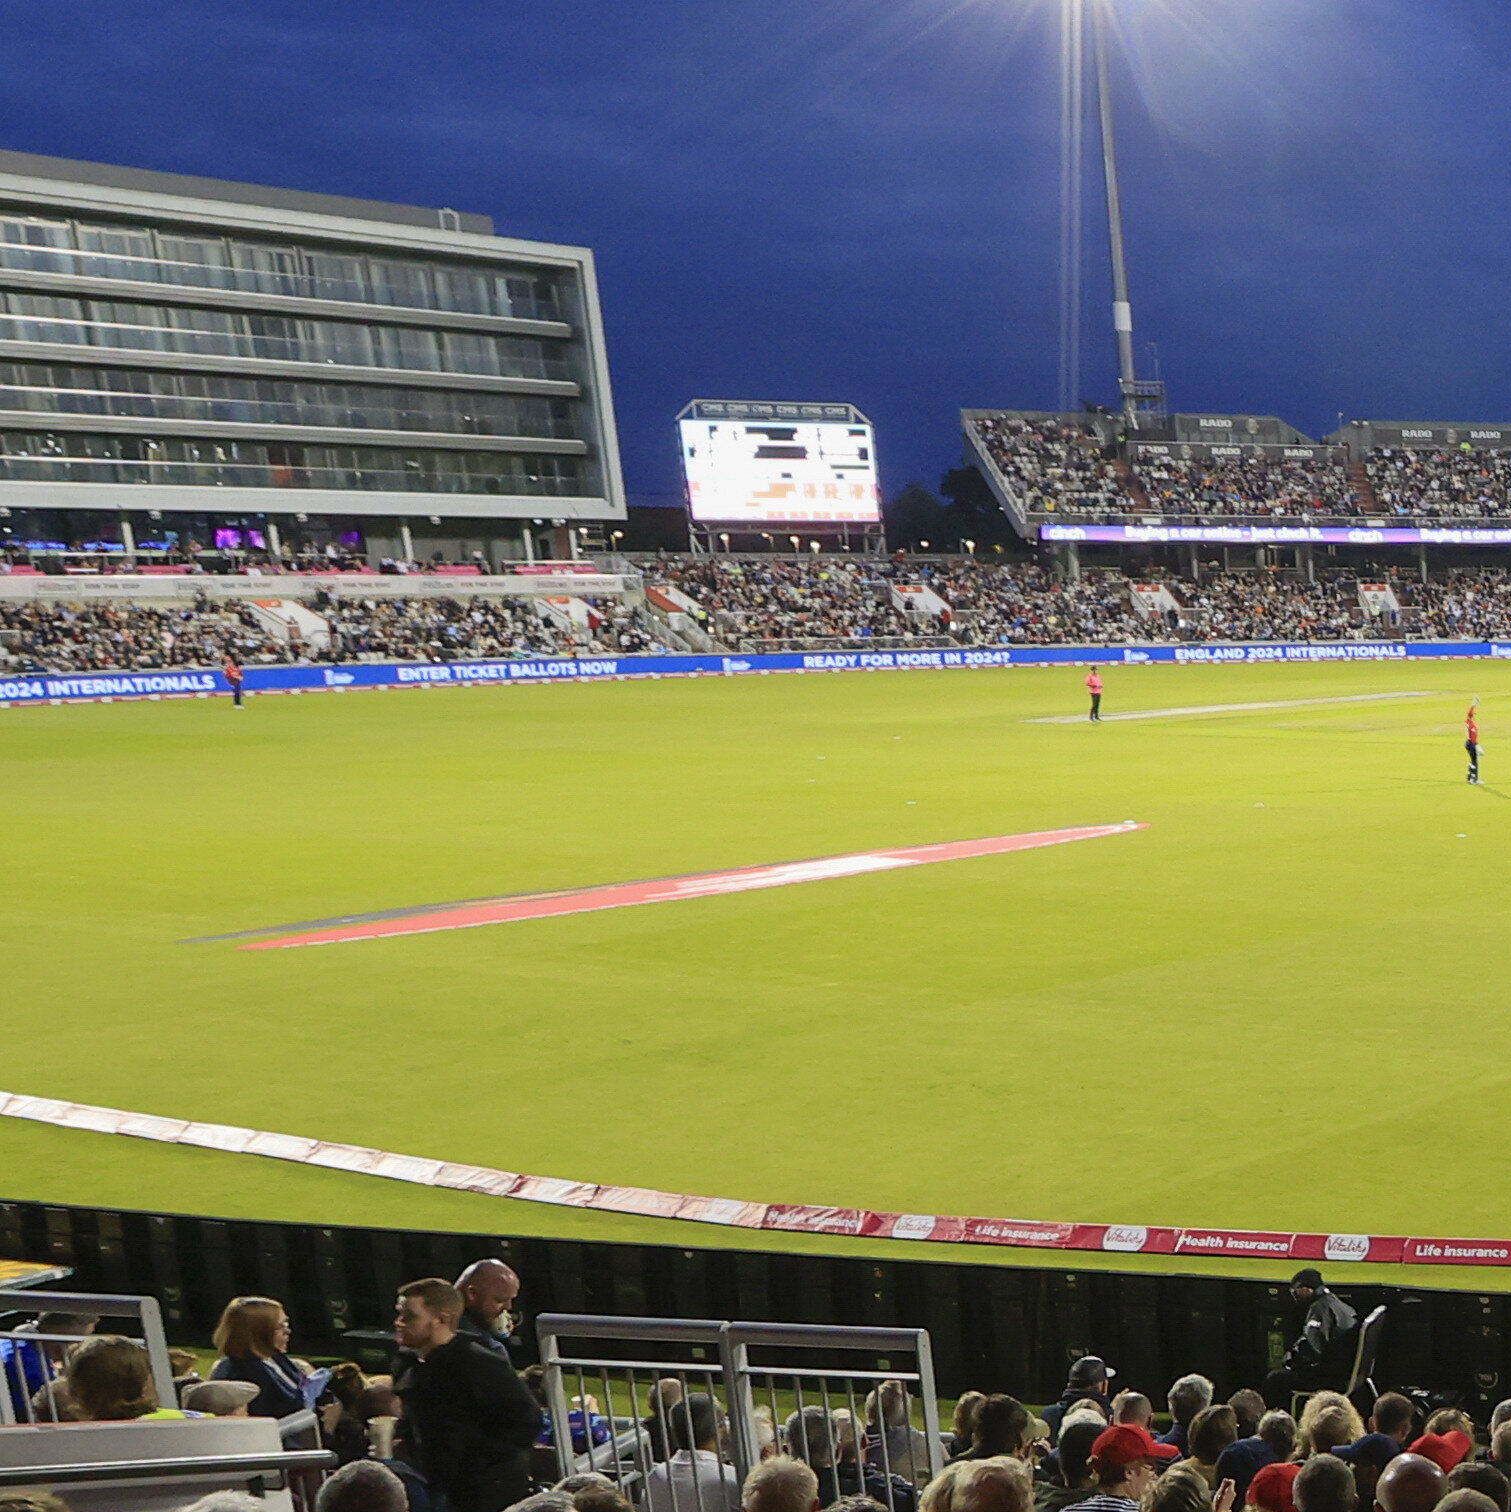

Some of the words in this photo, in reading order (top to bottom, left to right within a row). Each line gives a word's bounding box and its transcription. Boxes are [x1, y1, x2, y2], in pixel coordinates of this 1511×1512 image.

[804, 655, 858, 668] READY
[861, 654, 893, 668] FOR
[897, 652, 942, 667] MORE
[944, 652, 961, 665] IN
[964, 652, 1010, 665] 2024?
[1175, 648, 1245, 661] ENGLAND
[1248, 646, 1283, 660] 2024
[1286, 646, 1406, 659] INTERNATIONALS
[398, 667, 450, 682] ENTER
[451, 665, 506, 680] TICKET
[510, 663, 577, 678] BALLOTS
[579, 661, 617, 676] NOW
[0, 682, 44, 698] 2024
[50, 675, 216, 697] INTERNATIONALS
[976, 1225, 998, 1238] Life
[1000, 1227, 1060, 1241] insurance
[1105, 1228, 1147, 1247] Vitality
[1181, 1234, 1224, 1248] Health
[1226, 1237, 1289, 1252] insurance
[1326, 1236, 1368, 1255] Vitality
[1415, 1245, 1442, 1258] Life
[1443, 1245, 1509, 1259] insurance
